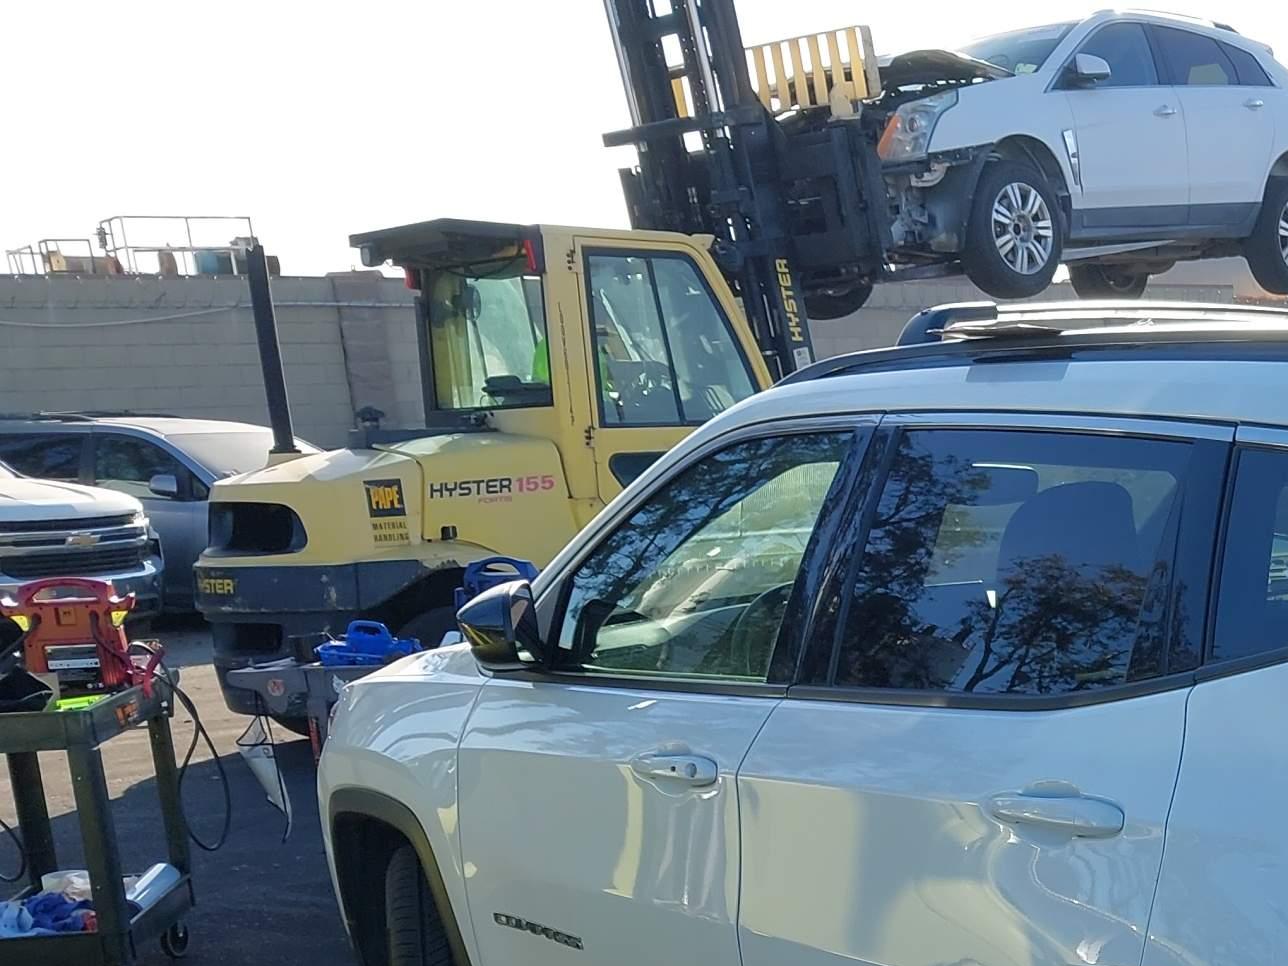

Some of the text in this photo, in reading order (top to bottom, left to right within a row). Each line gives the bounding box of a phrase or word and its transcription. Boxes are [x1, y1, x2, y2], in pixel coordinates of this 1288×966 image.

[775, 258, 804, 342] HYSTER
[429, 474, 555, 499] HYSTER 155
[372, 521, 407, 530] MATERIAL
[374, 532, 410, 542] HANDLING
